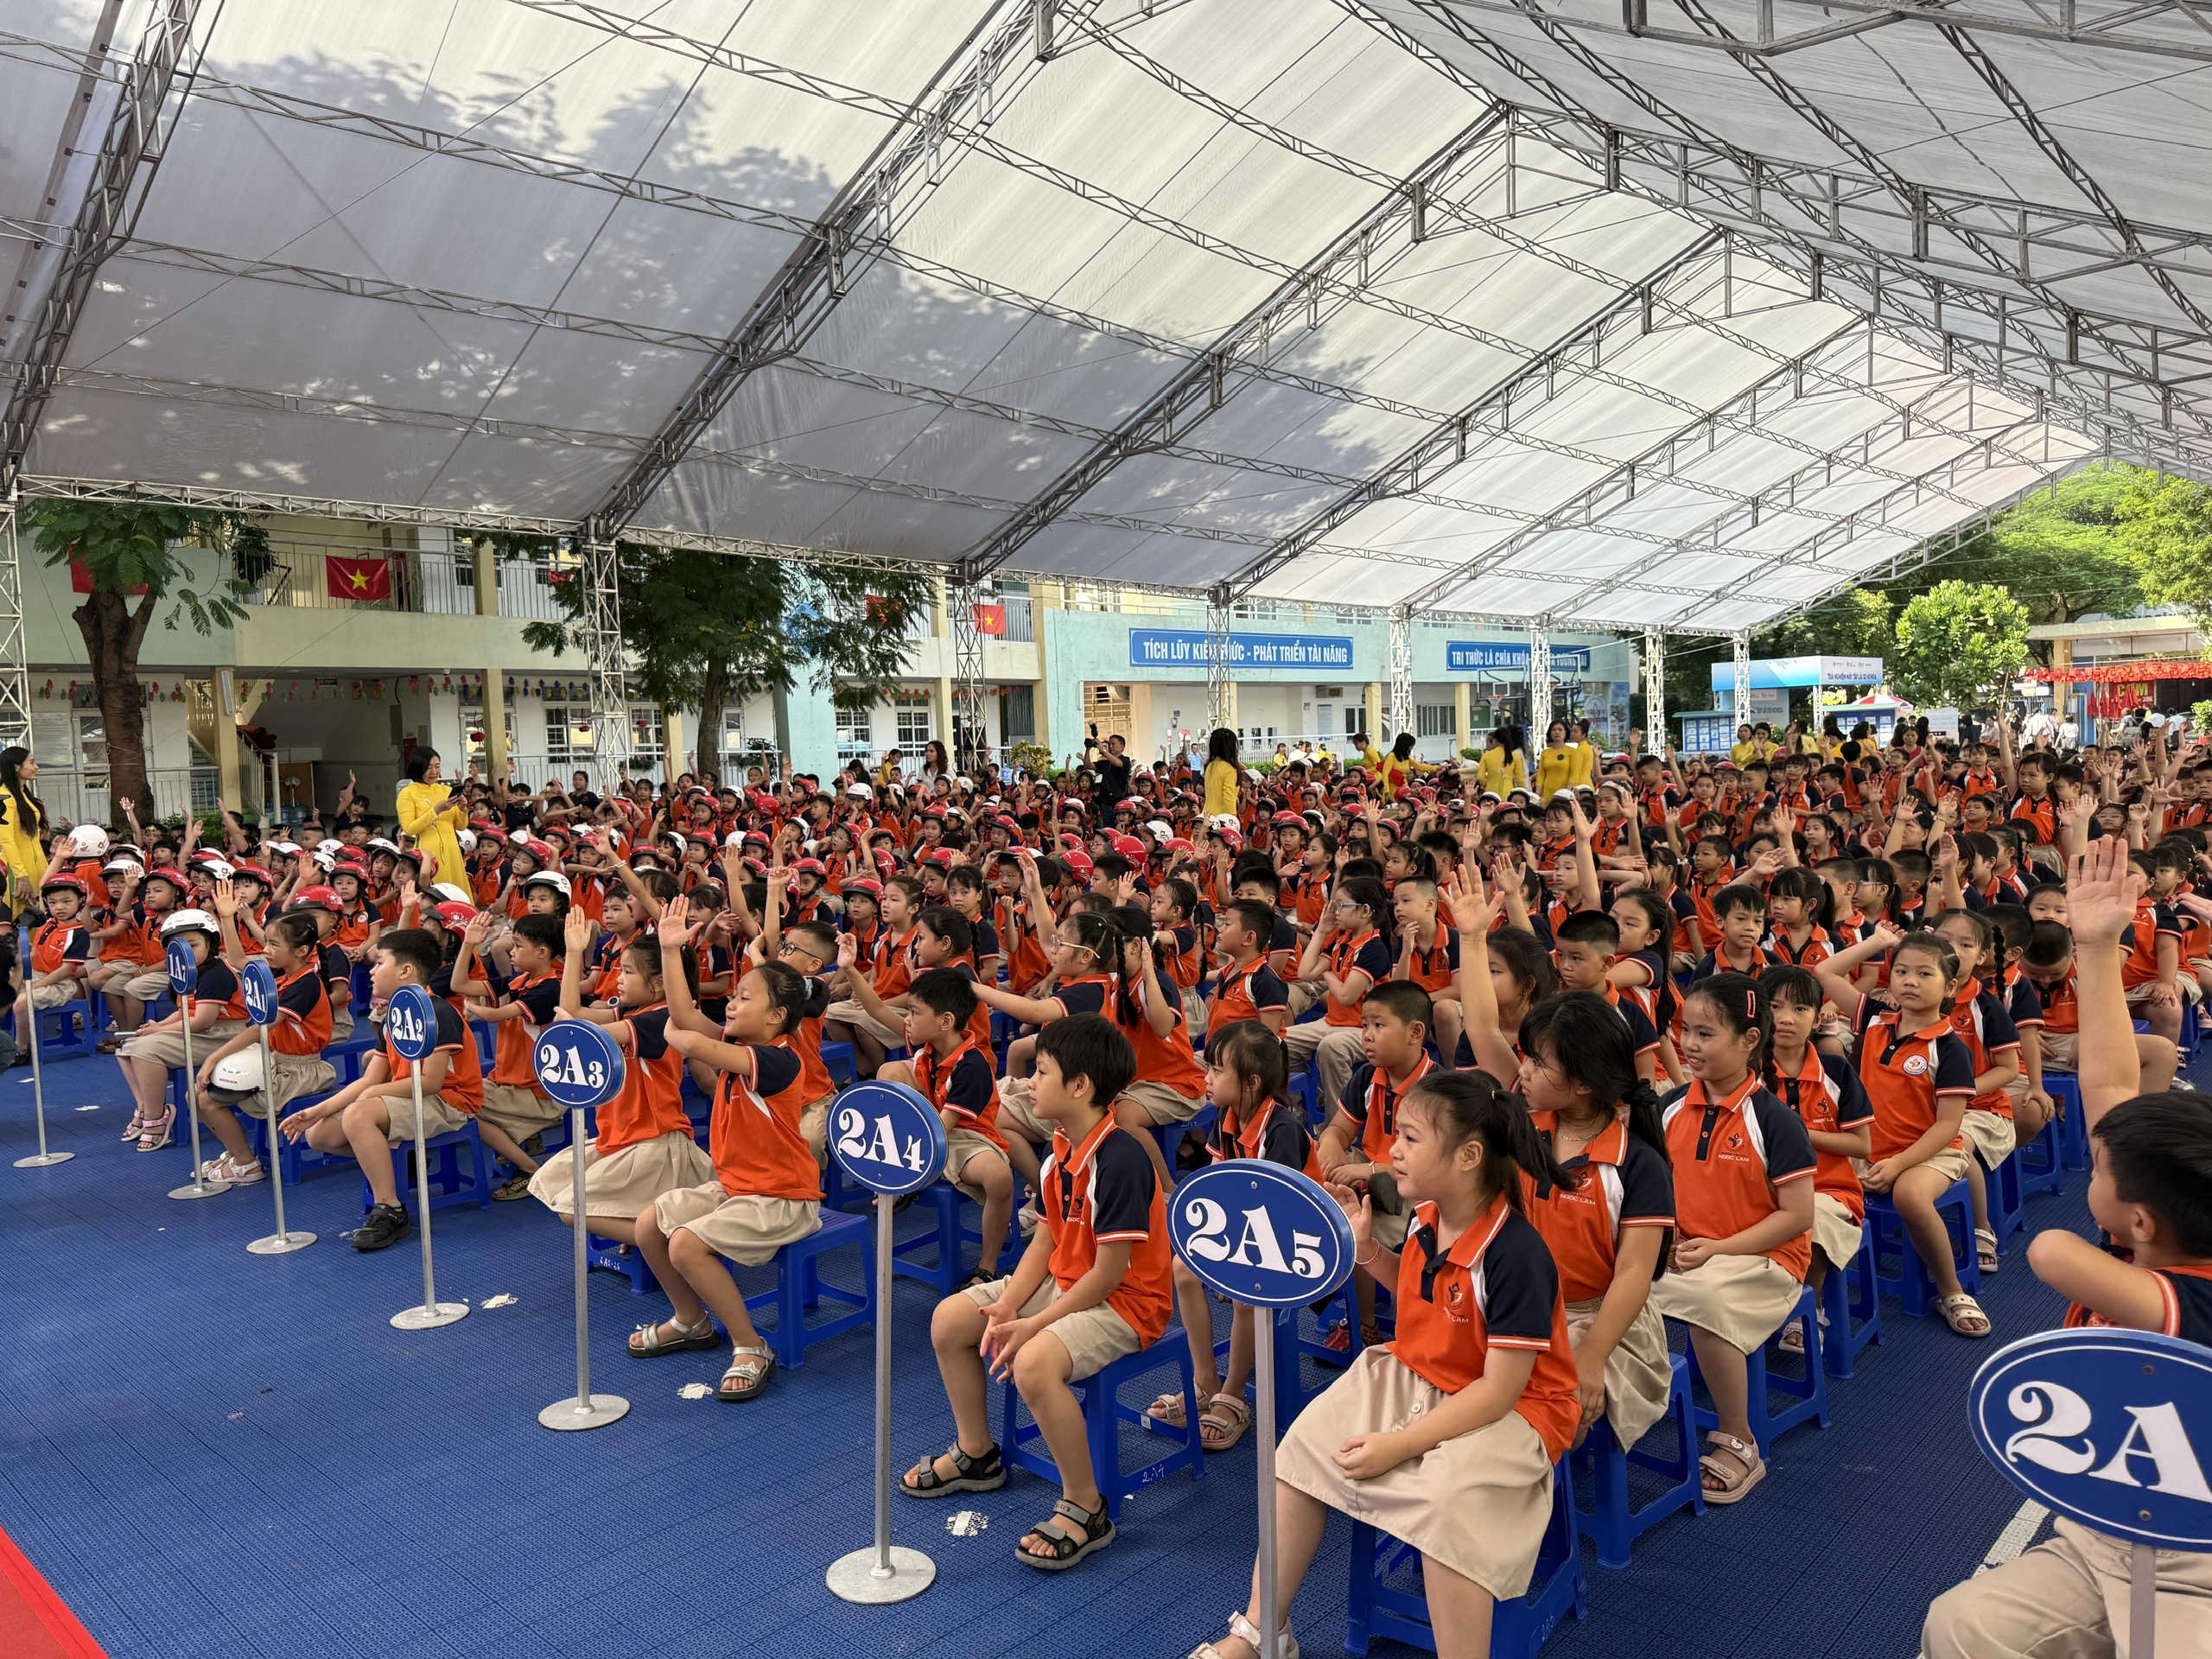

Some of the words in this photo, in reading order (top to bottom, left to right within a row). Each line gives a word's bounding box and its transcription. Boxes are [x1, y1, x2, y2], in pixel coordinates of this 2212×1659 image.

[1143, 638, 1168, 659] TÍCH
[1171, 639, 1190, 659] LŨY
[1253, 642, 1277, 662] PHÁT
[1279, 639, 1306, 662] TRIỂN
[1307, 644, 1321, 663] TÀI
[1324, 645, 1347, 663] NĂNG
[1452, 652, 1464, 665] TRI
[1465, 649, 1484, 665] THỨC
[1484, 649, 1493, 665] LÀ
[1495, 650, 1511, 665] CHÌA
[168, 953, 186, 982] 1A7
[245, 977, 267, 1013] 2A1
[391, 1007, 423, 1043] 2A2
[540, 1044, 604, 1089] 2A3
[837, 1108, 925, 1173] 2A4
[1185, 1198, 1325, 1279] 2A5
